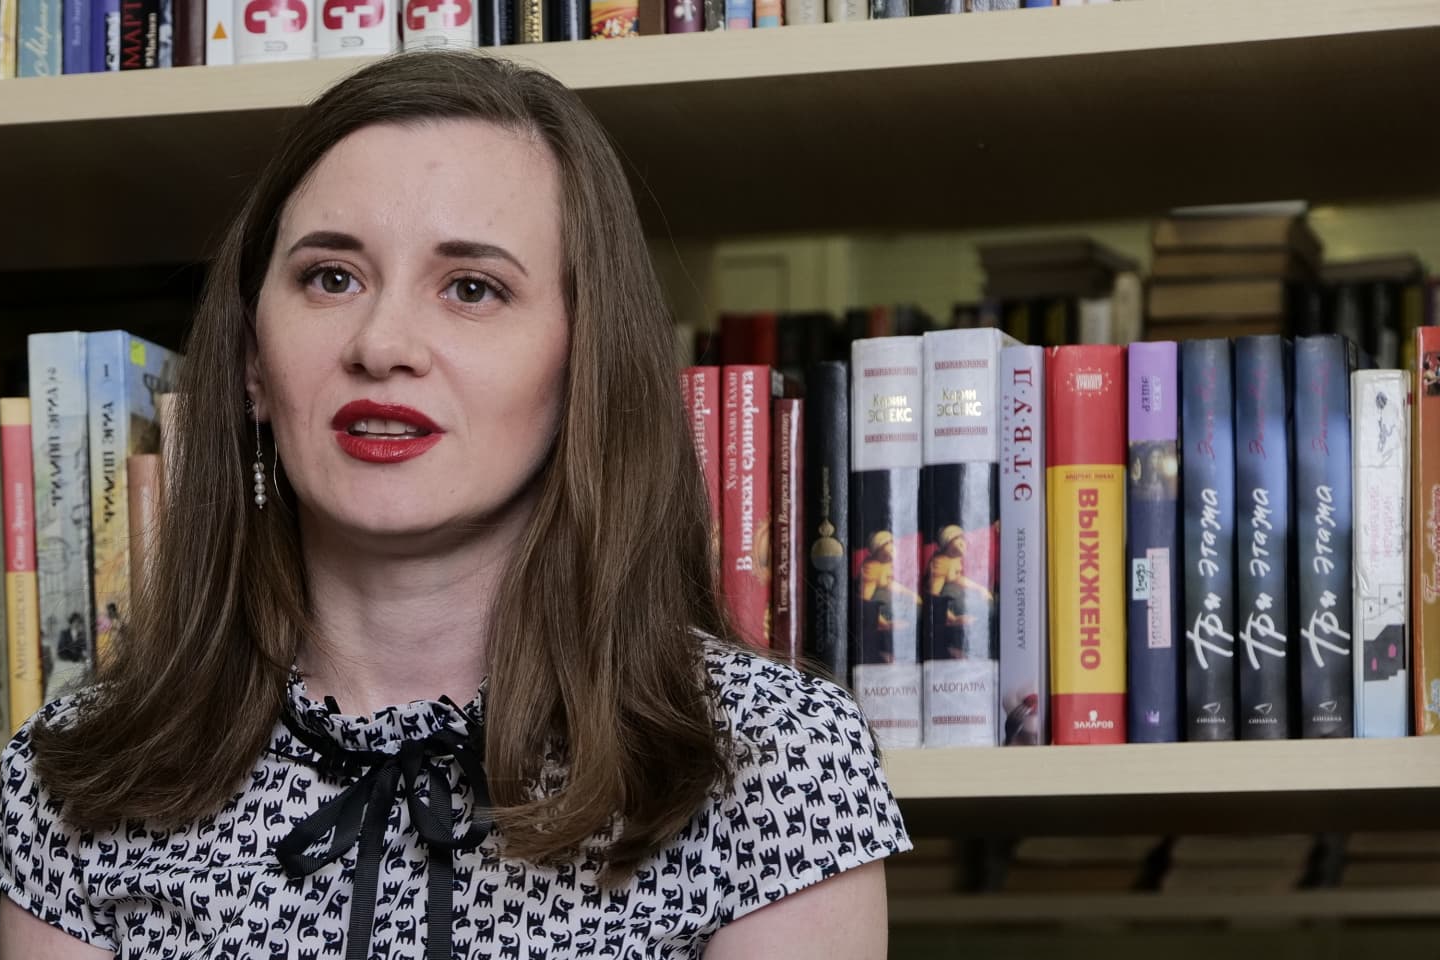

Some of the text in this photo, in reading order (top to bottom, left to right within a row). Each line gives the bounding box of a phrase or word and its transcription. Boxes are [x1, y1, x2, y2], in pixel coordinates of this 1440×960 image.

[692, 372, 711, 464] динорога
[725, 372, 739, 490] Хуан Эслава Галан
[873, 393, 907, 408] Карин
[936, 401, 982, 417] ЭССЕКС
[942, 388, 977, 402] Карин
[736, 370, 759, 571] В поисках единорога
[778, 474, 791, 523] Вопреки
[1015, 528, 1027, 650] ЛАКОМЫЙ КУСОЧЕК
[1077, 488, 1101, 671] ВЫЖЖЕНО
[1186, 487, 1234, 670] Три этажа
[1239, 487, 1287, 670] Три этажа
[1301, 484, 1351, 670] Три этажа
[864, 686, 918, 697] КЛЕОПАТРА
[932, 682, 986, 694] КЛЕОПАТРА
[1073, 719, 1115, 730] ЗАХАРОВ
